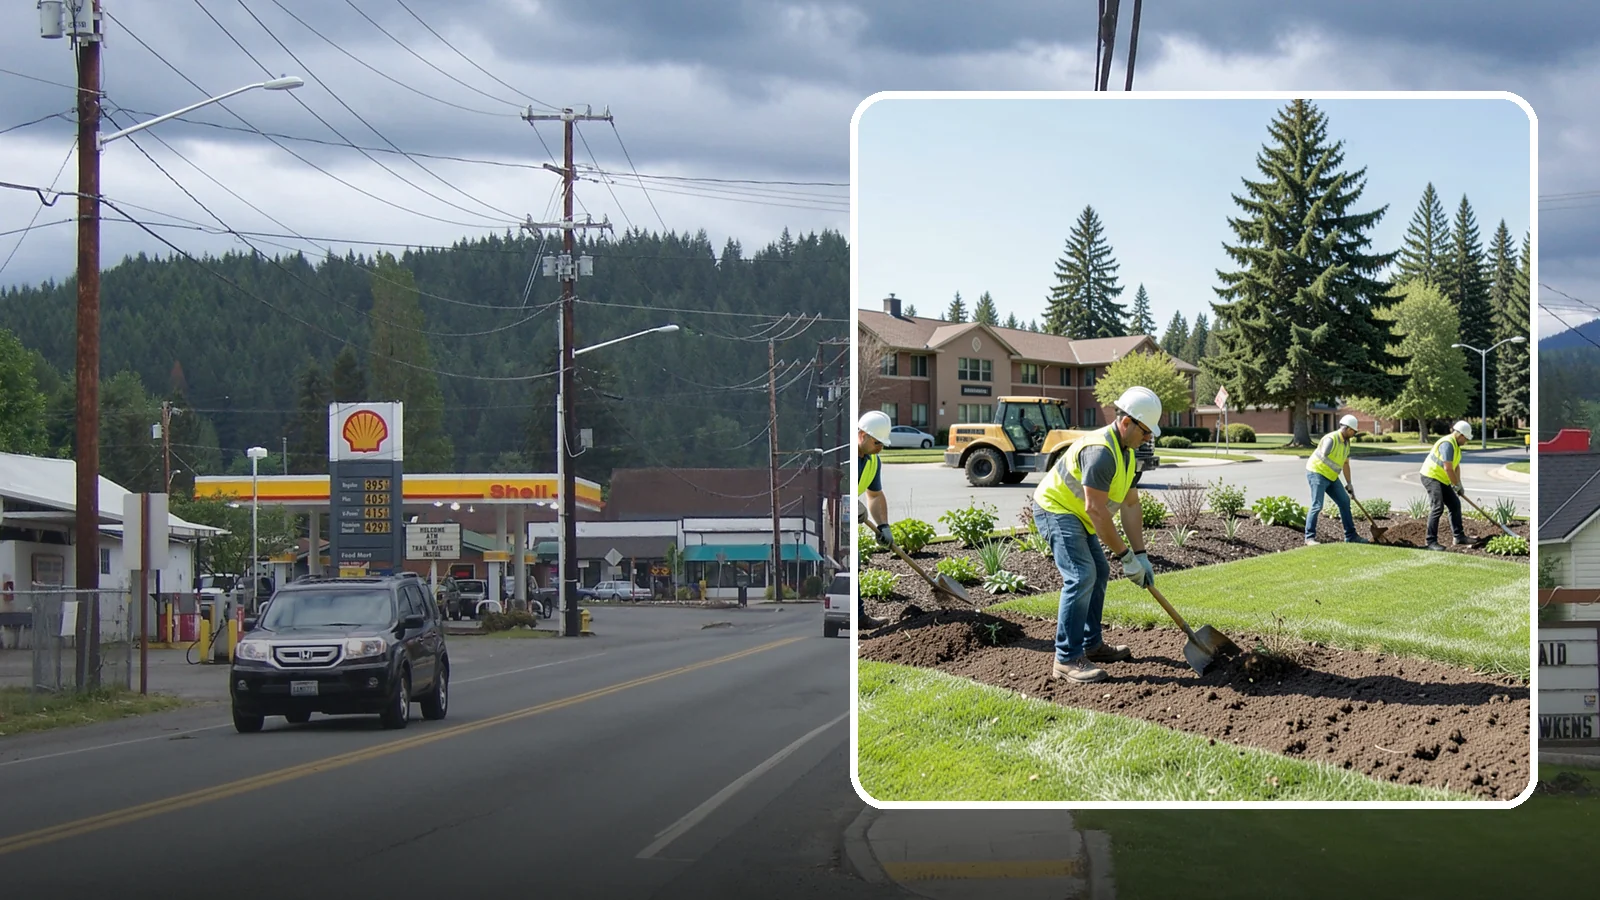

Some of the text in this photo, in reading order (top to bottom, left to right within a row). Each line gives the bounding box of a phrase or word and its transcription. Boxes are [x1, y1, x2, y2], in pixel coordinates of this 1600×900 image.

[366, 480, 384, 490] 395
[490, 484, 547, 499] Shell
[366, 494, 384, 504] 405
[366, 508, 384, 518] 415
[366, 522, 384, 533] 429
